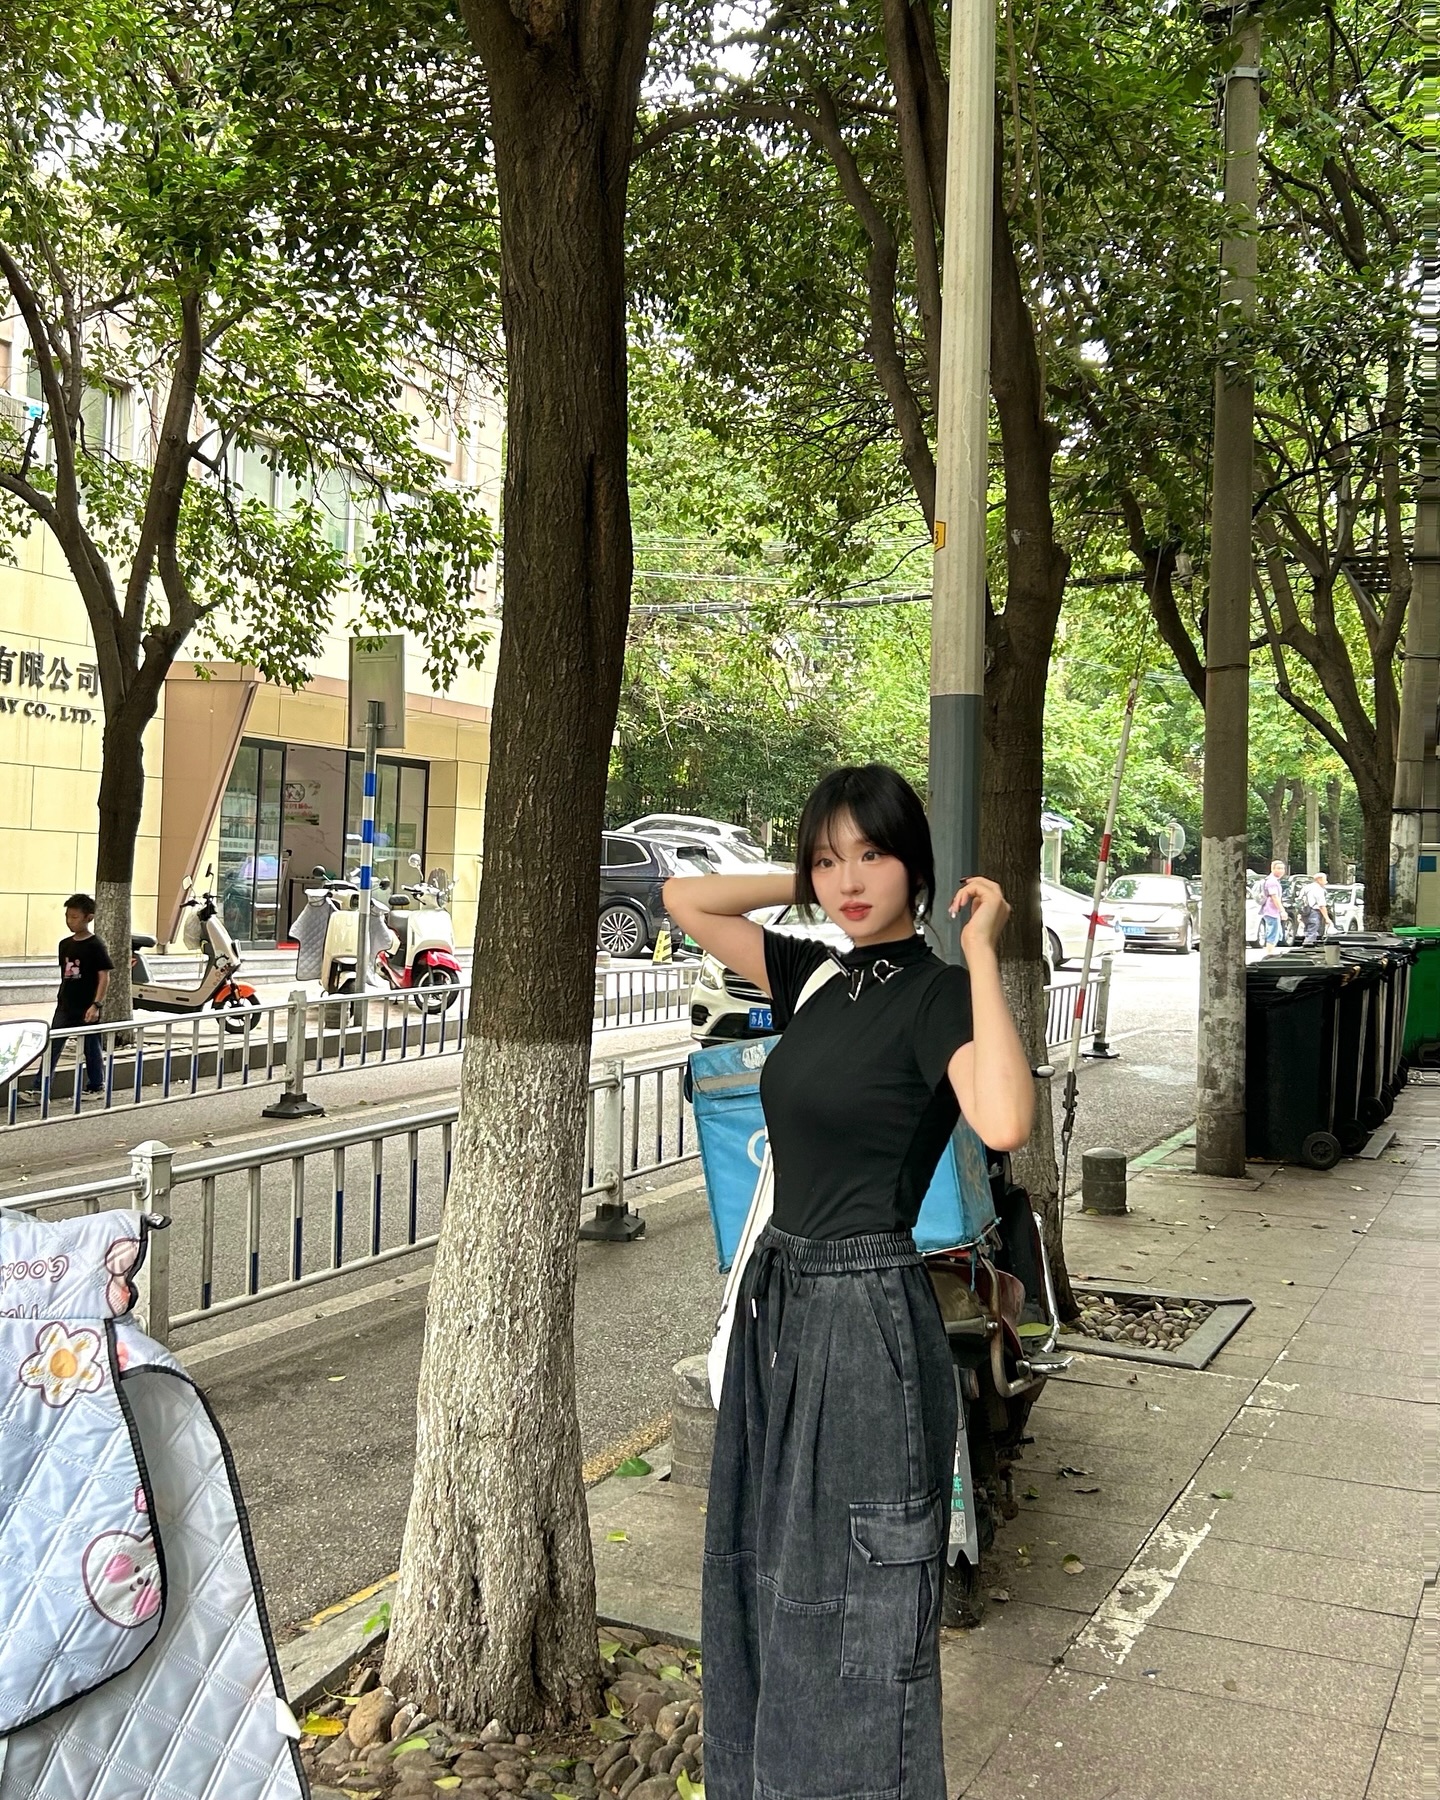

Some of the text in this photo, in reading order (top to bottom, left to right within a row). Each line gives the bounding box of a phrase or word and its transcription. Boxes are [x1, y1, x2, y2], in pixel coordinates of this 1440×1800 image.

[0, 646, 99, 698] 有限公司
[60, 707, 96, 725] LTD.
